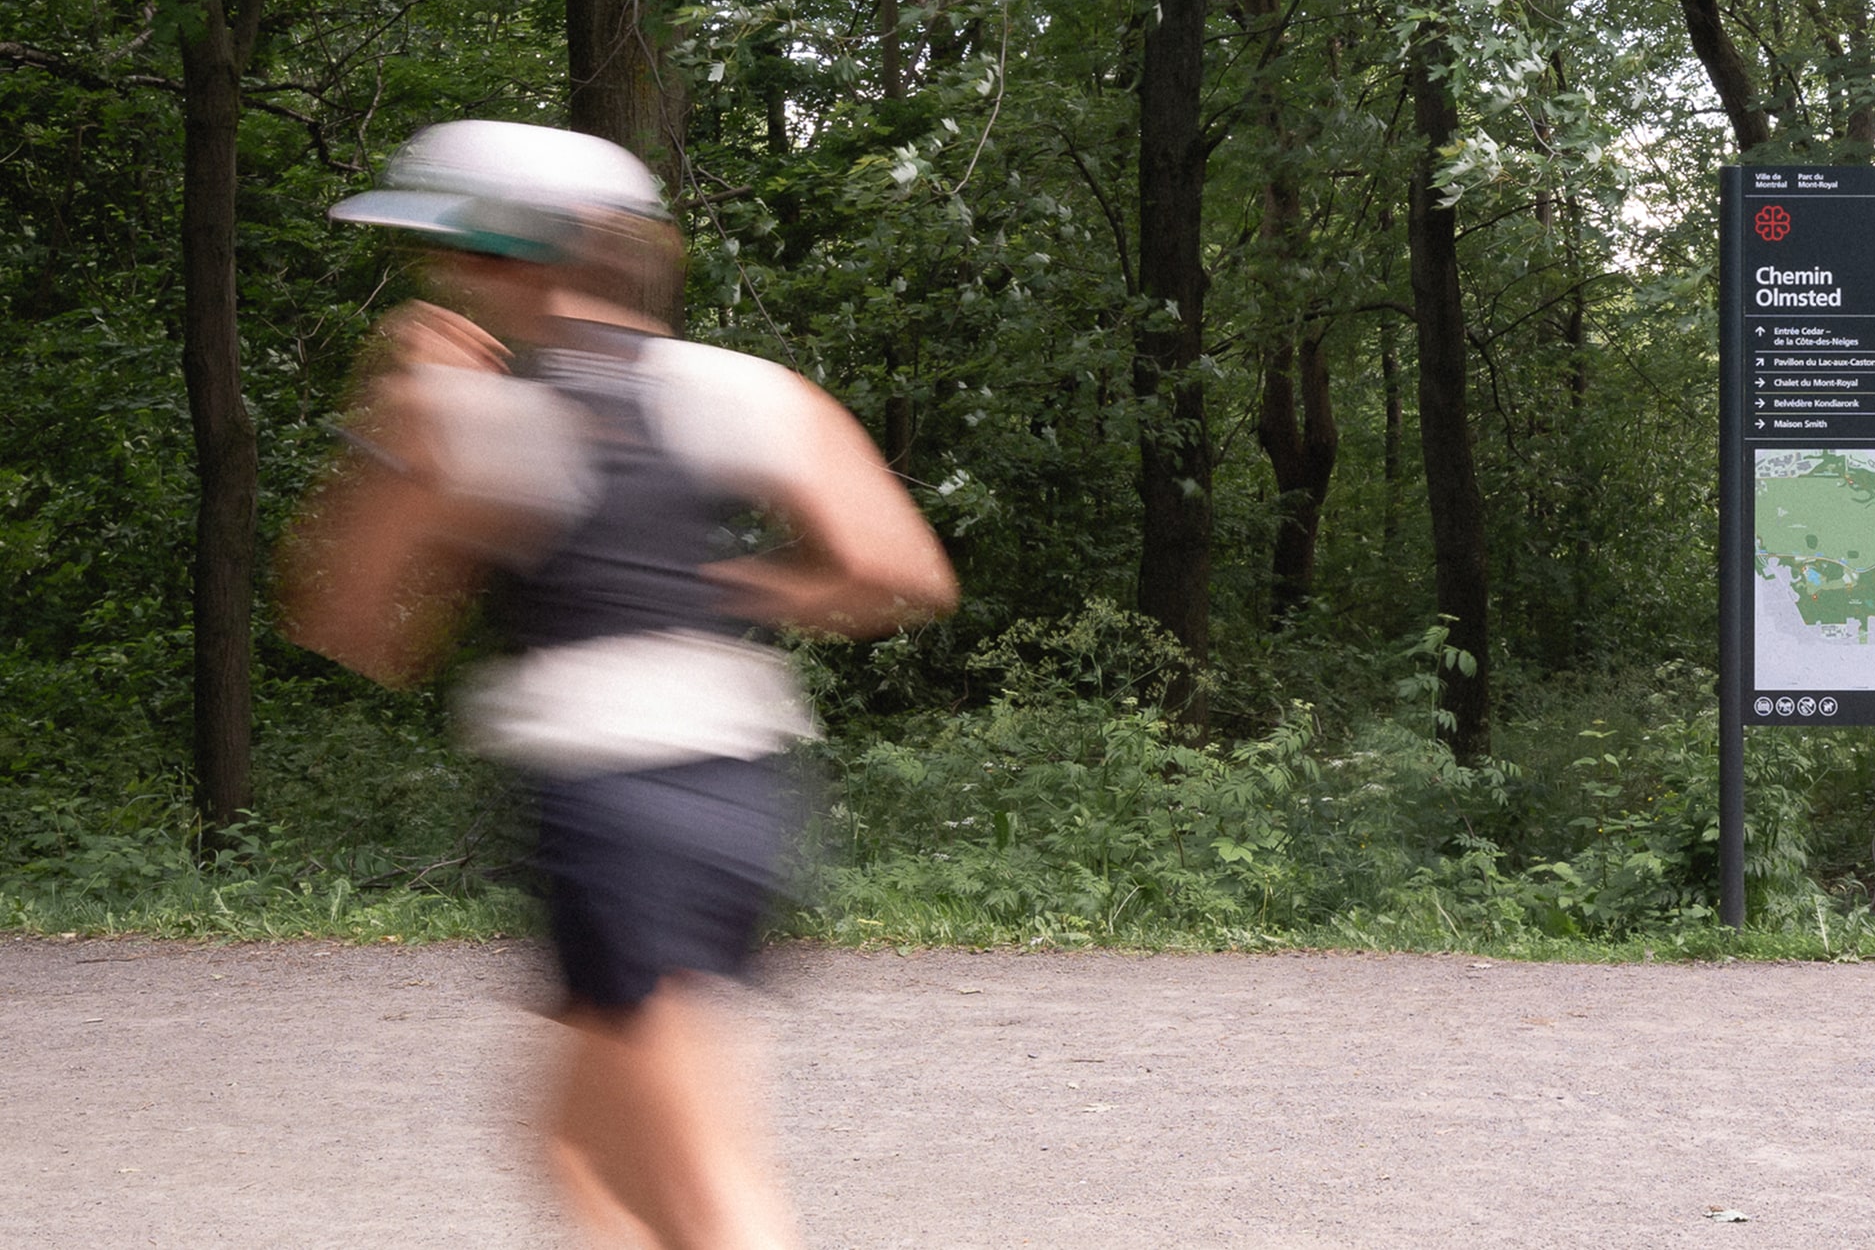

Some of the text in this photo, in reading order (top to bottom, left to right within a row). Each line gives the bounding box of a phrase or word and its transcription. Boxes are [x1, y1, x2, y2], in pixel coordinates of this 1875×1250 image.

[1755, 173, 1782, 181] Ville de
[1797, 173, 1824, 181] Parc du
[1797, 181, 1838, 190] Mont-Royal
[1756, 266, 1833, 285] Chemin
[1756, 288, 1841, 307] Olmsted
[1773, 327, 1800, 336] Entrée
[1801, 327, 1825, 336] Cedar
[1773, 337, 1859, 348] de la Côte-des-Neiges
[1773, 357, 1805, 367] Pavillon
[1805, 357, 1817, 367] du
[1773, 378, 1859, 389] Chalet du Mont-Royal
[1773, 398, 1860, 408] Belvédère Kondiaronk
[1773, 419, 1828, 428] Maison Smith
